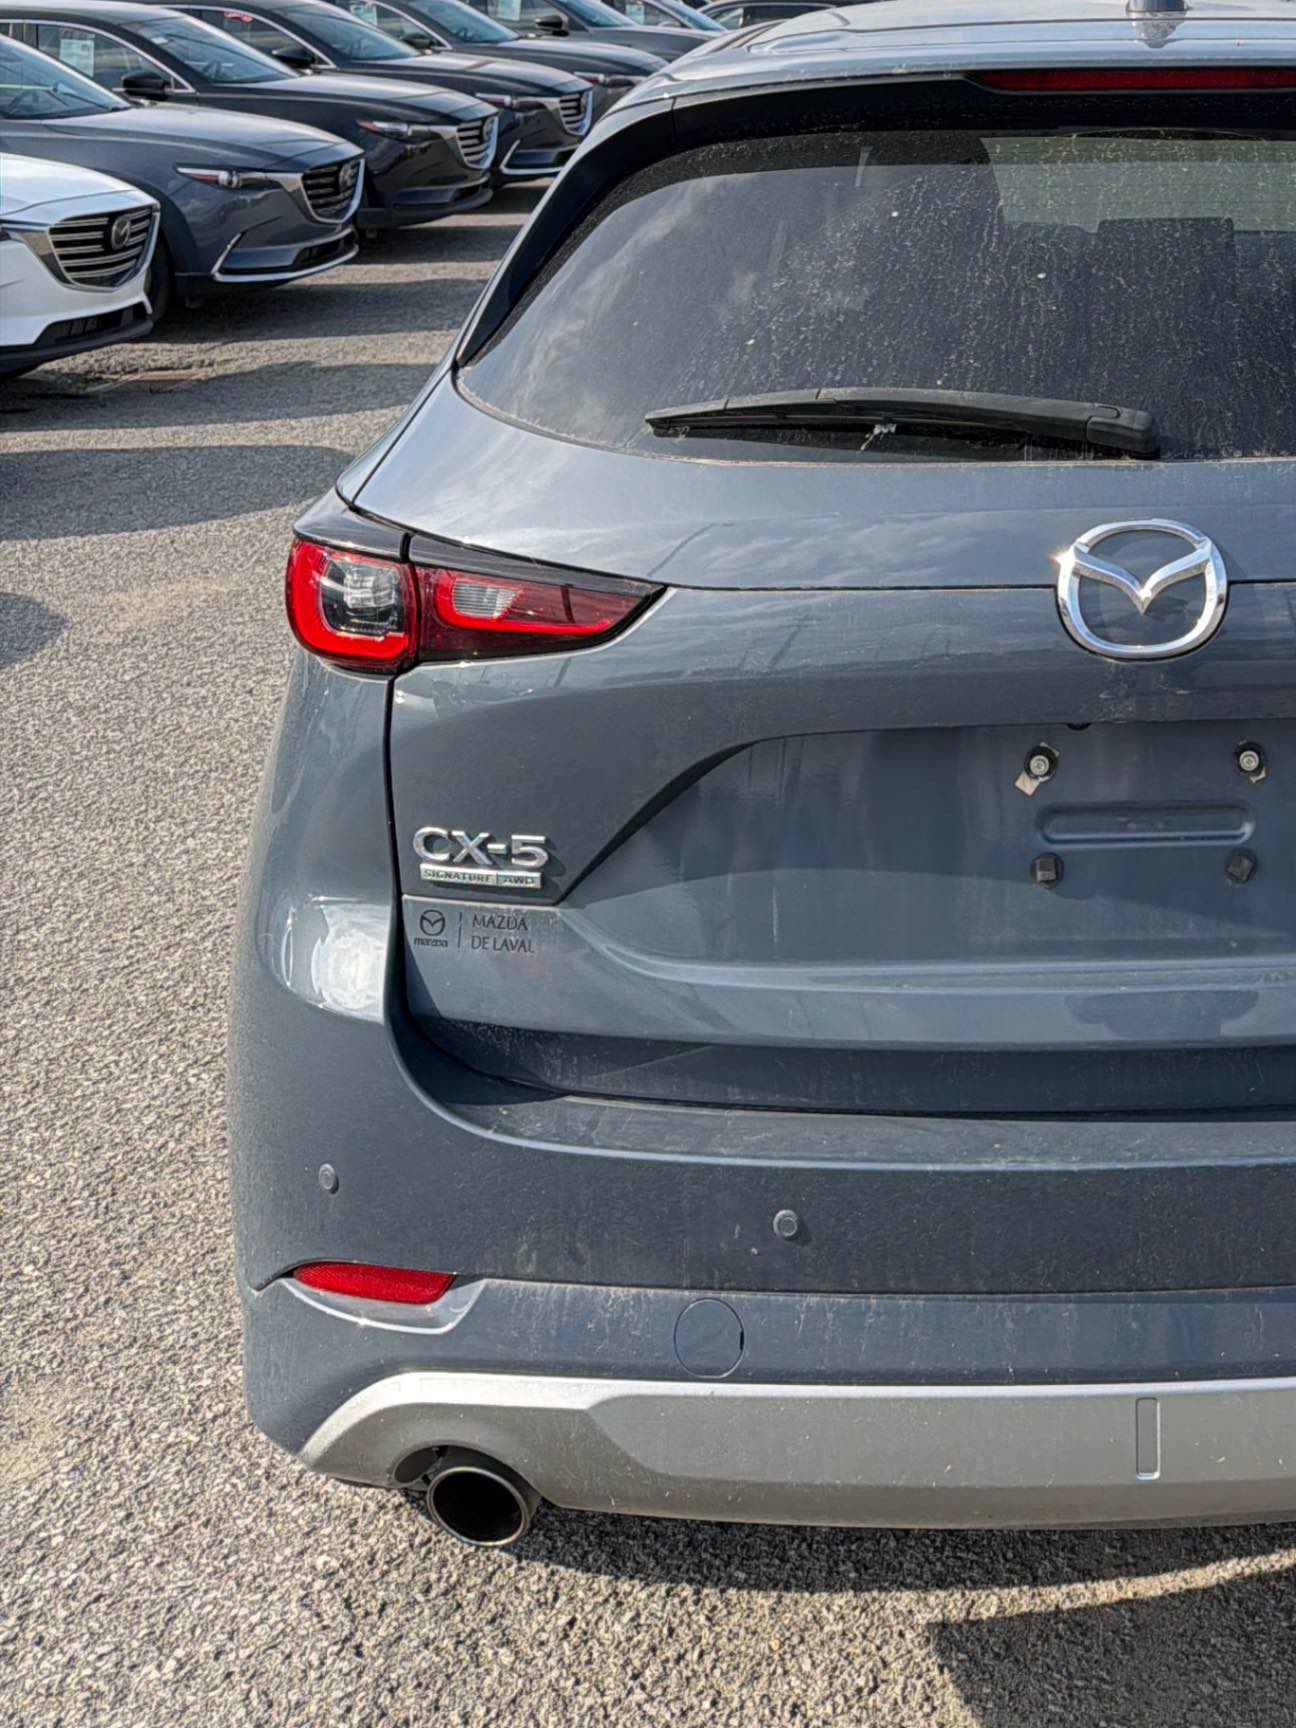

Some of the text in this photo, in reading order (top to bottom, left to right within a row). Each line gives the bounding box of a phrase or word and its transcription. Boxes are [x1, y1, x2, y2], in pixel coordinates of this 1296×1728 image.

[412, 826, 549, 869] CX-5
[423, 869, 536, 885] SIGNATURE AWD
[472, 914, 528, 931] MAZDA
[471, 936, 535, 953] DE LAVAL
